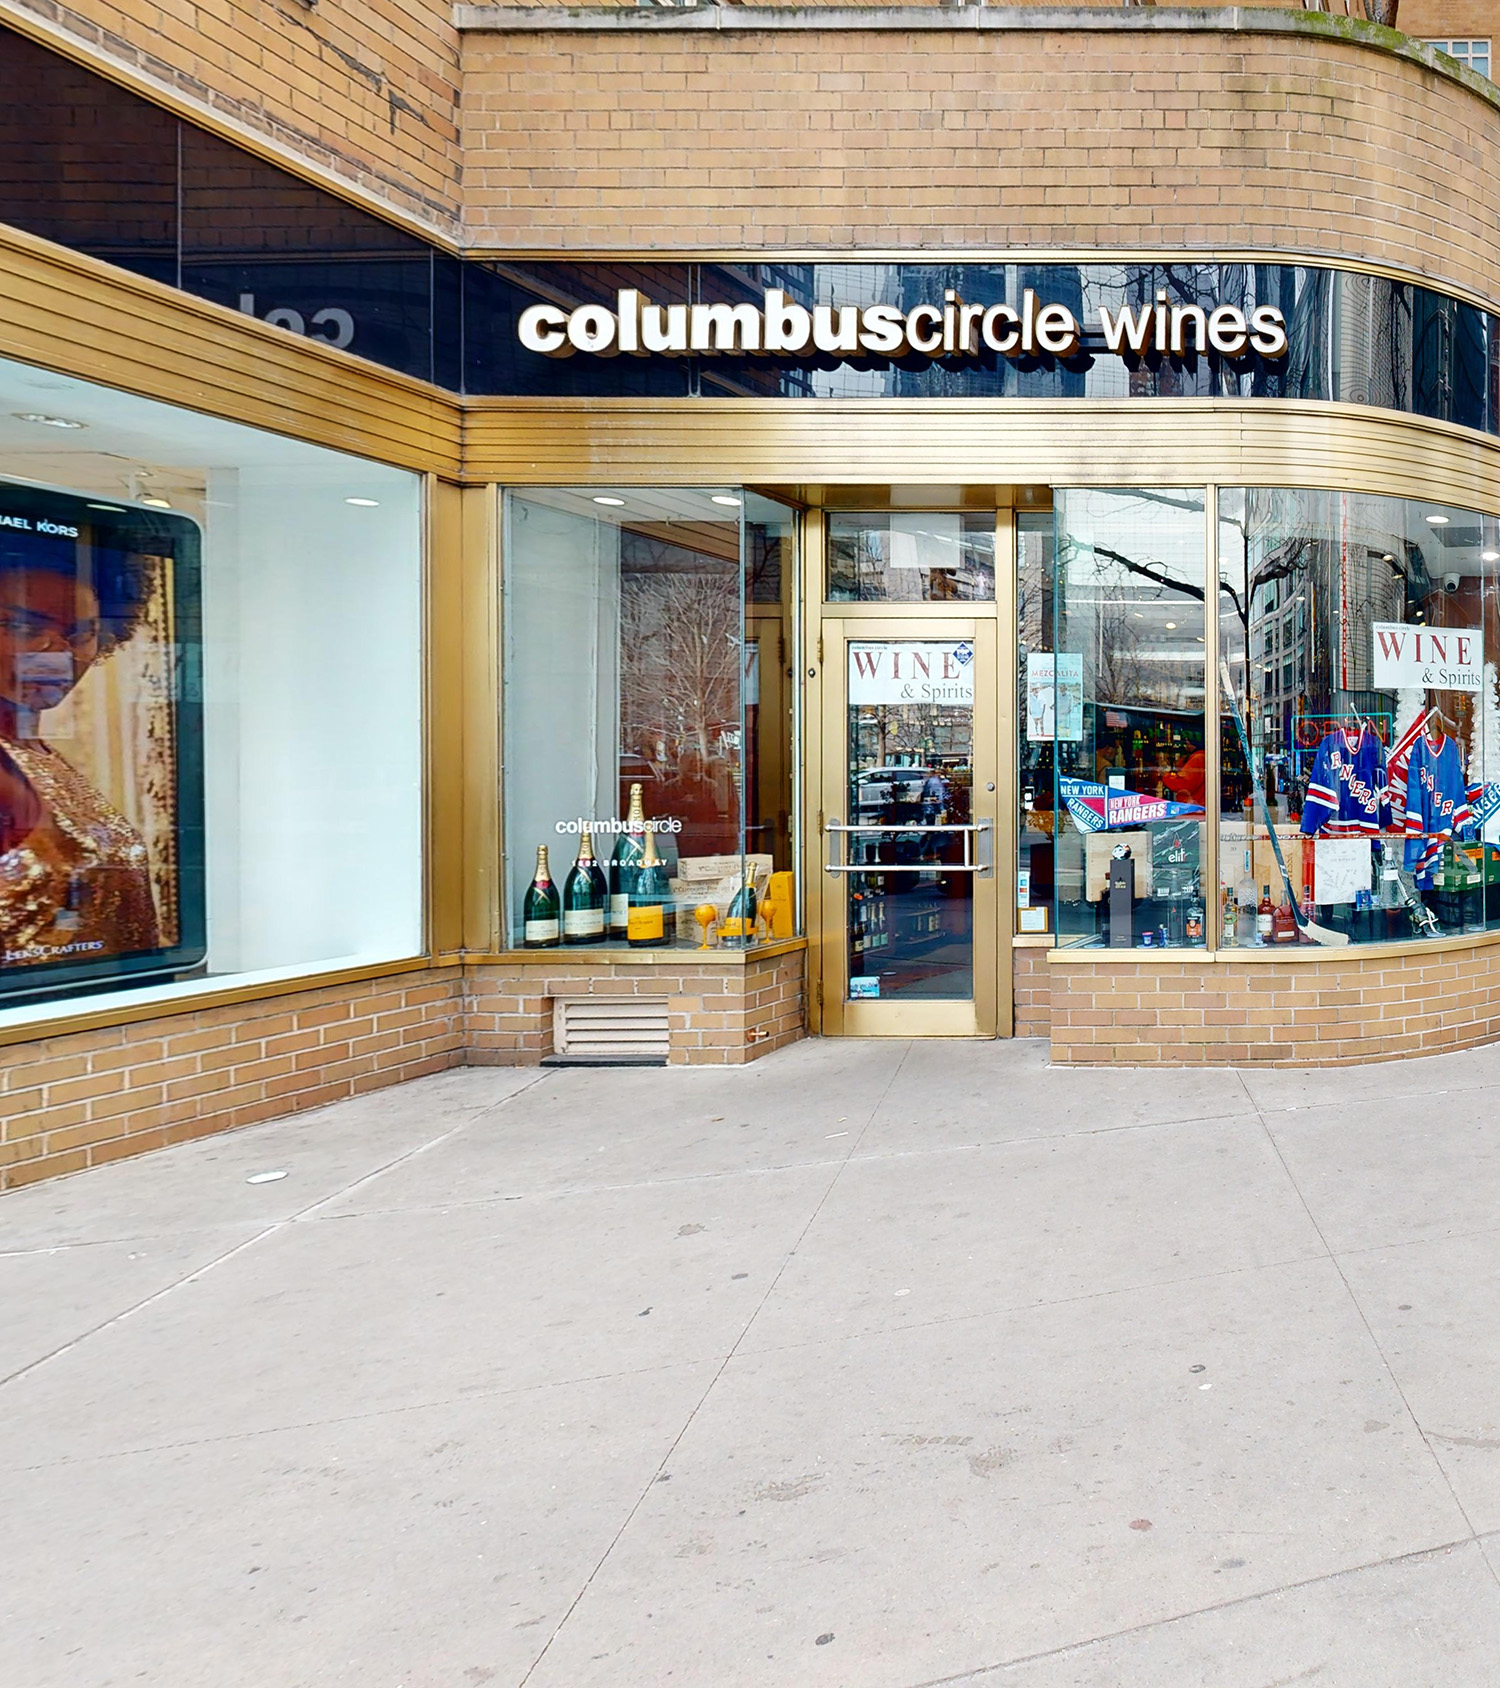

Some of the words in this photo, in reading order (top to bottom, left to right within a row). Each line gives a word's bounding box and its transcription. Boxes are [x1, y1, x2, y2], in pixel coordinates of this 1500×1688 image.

[518, 288, 1079, 353] columbuscircle
[1099, 288, 1288, 354] wines
[36, 520, 79, 538] KORS
[1377, 631, 1472, 666] WINE
[852, 651, 961, 680] WINE
[1421, 667, 1433, 684] &
[1439, 668, 1481, 688] Spirits
[900, 683, 914, 699] &
[921, 682, 973, 703] Spirits
[1296, 718, 1387, 747] OPN
[1060, 785, 1079, 795] NEW
[1081, 785, 1104, 795] YORK
[1066, 797, 1104, 829] RANGERS
[1109, 798, 1123, 810] NEW
[1123, 796, 1141, 808] YORK
[1109, 803, 1168, 825] RANGERS
[603, 859, 668, 867] BROADWAY
